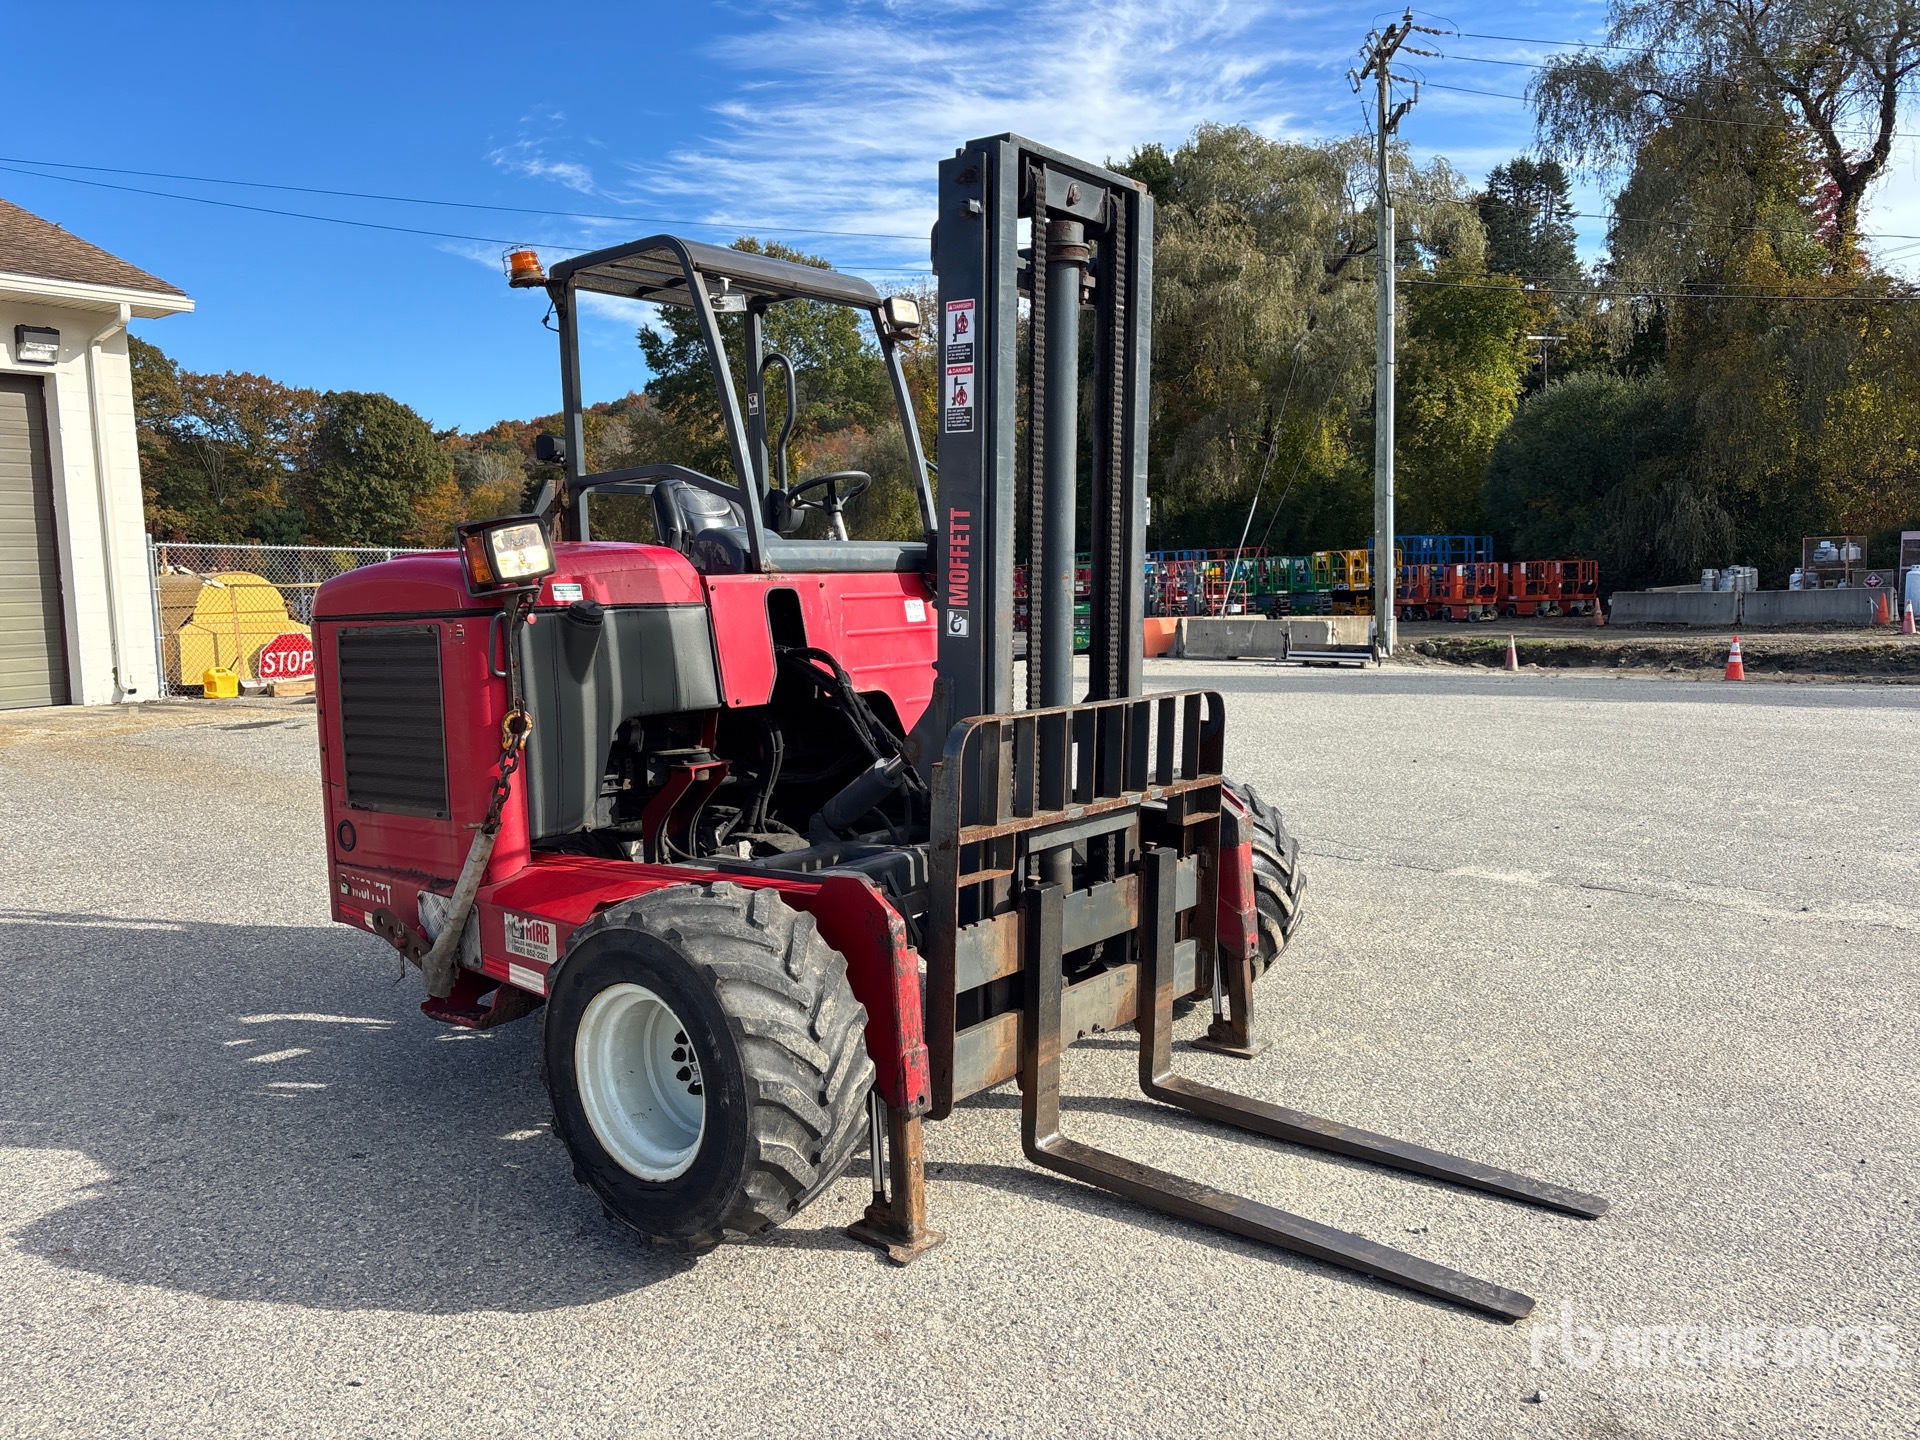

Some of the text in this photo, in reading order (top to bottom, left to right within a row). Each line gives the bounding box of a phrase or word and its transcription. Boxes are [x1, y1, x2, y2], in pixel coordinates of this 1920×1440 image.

[952, 302, 972, 310] DANGER
[951, 366, 971, 374] DANGER
[949, 507, 970, 606] MOFFETT
[264, 650, 313, 673] STOP
[525, 922, 549, 945] MIAB
[512, 944, 549, 961] (800) 852-2331
